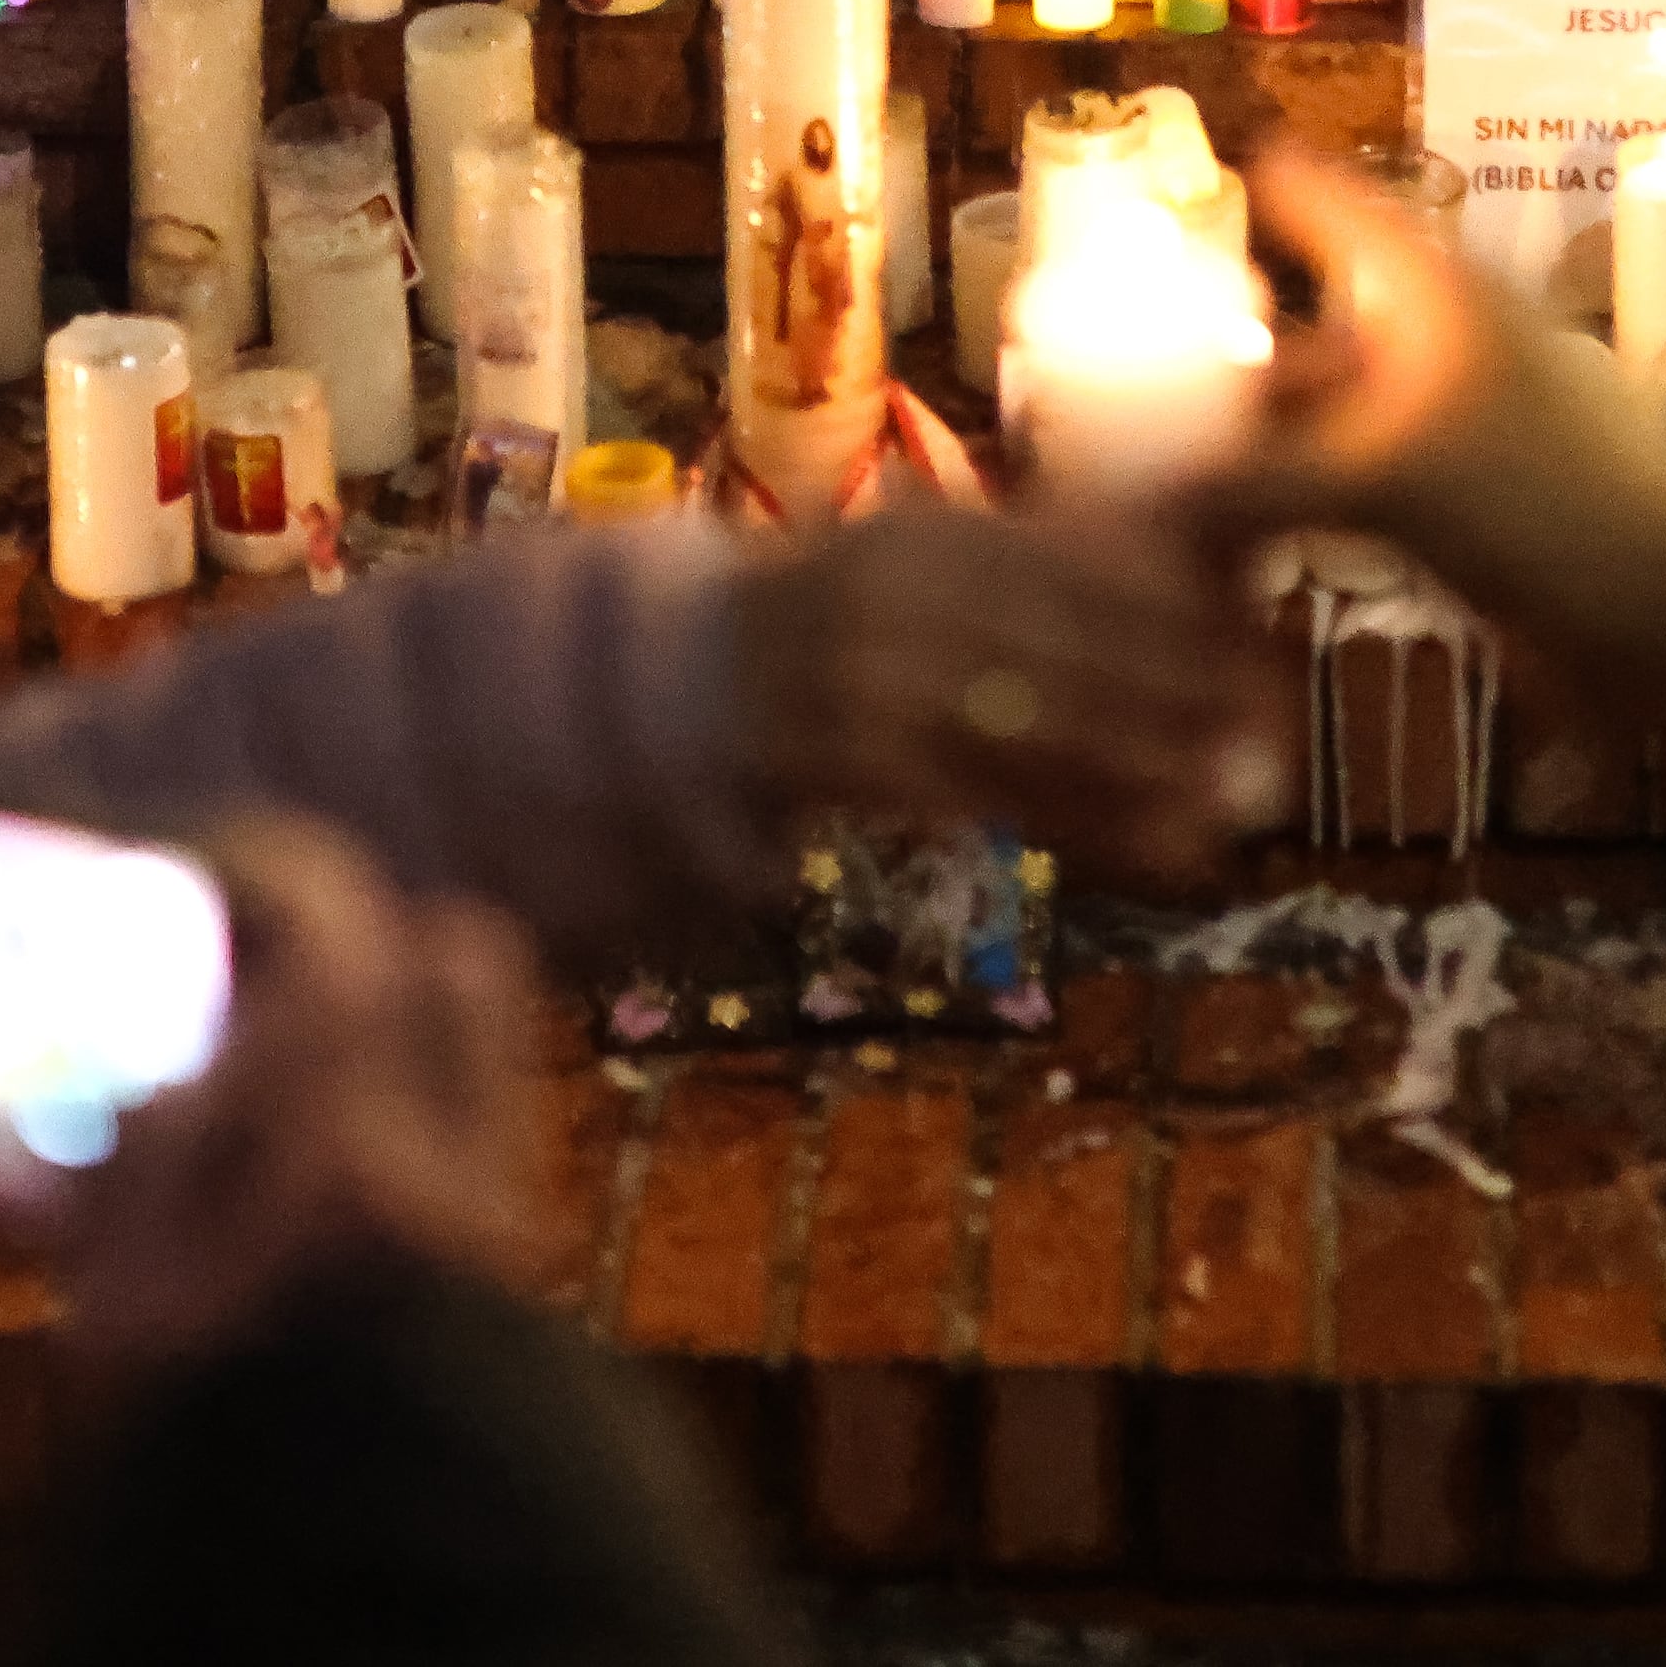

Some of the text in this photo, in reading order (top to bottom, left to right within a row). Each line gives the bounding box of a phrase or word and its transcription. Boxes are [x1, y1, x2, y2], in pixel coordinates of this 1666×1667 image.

[1474, 116, 1529, 142] SIN
[1539, 117, 1575, 142] MI
[1471, 164, 1589, 195] (BIBLIA
